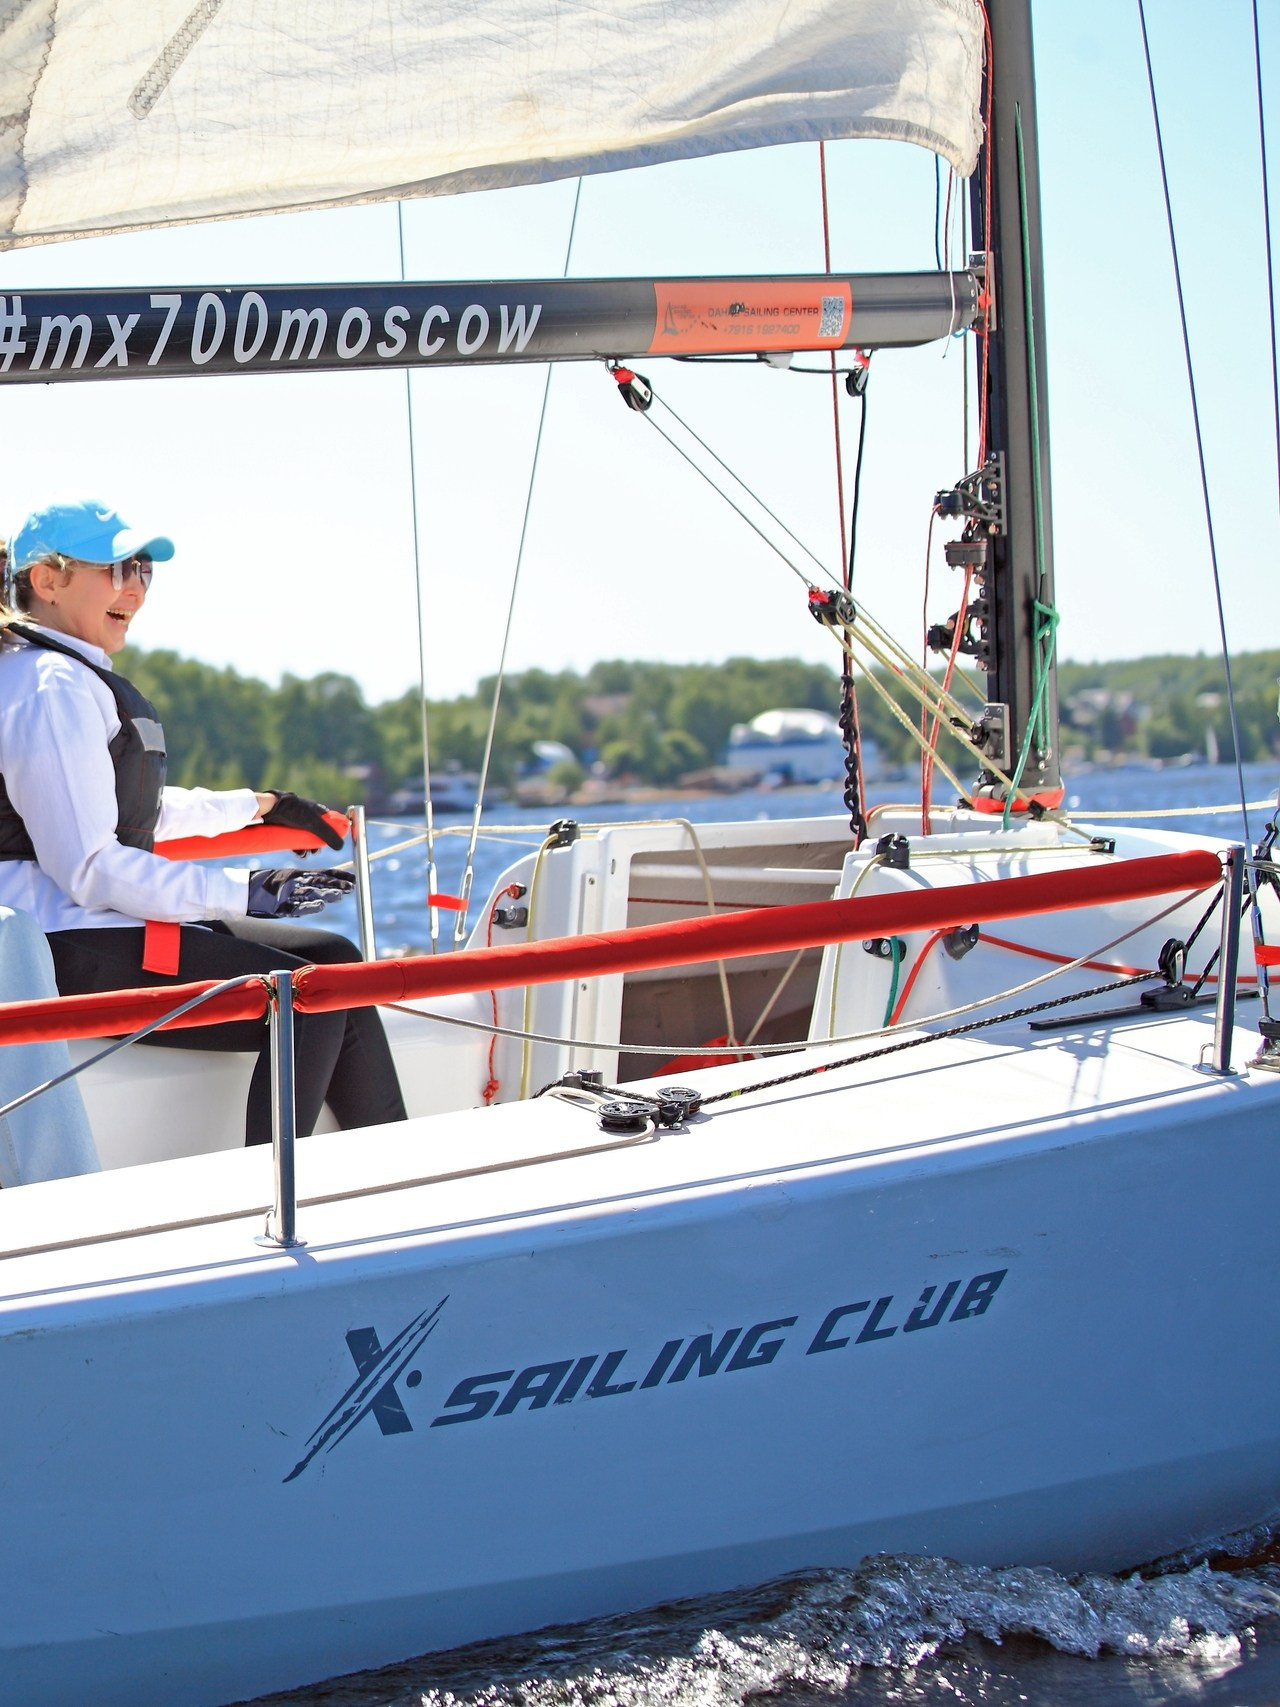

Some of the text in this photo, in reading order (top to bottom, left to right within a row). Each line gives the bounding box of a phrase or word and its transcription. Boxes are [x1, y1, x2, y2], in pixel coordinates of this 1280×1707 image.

[708, 307, 743, 317] DAH
[745, 307, 779, 317] SAILING
[783, 307, 819, 316] CENTER
[429, 1315, 800, 1429] SAILING
[806, 1268, 1009, 1356] CLUB
